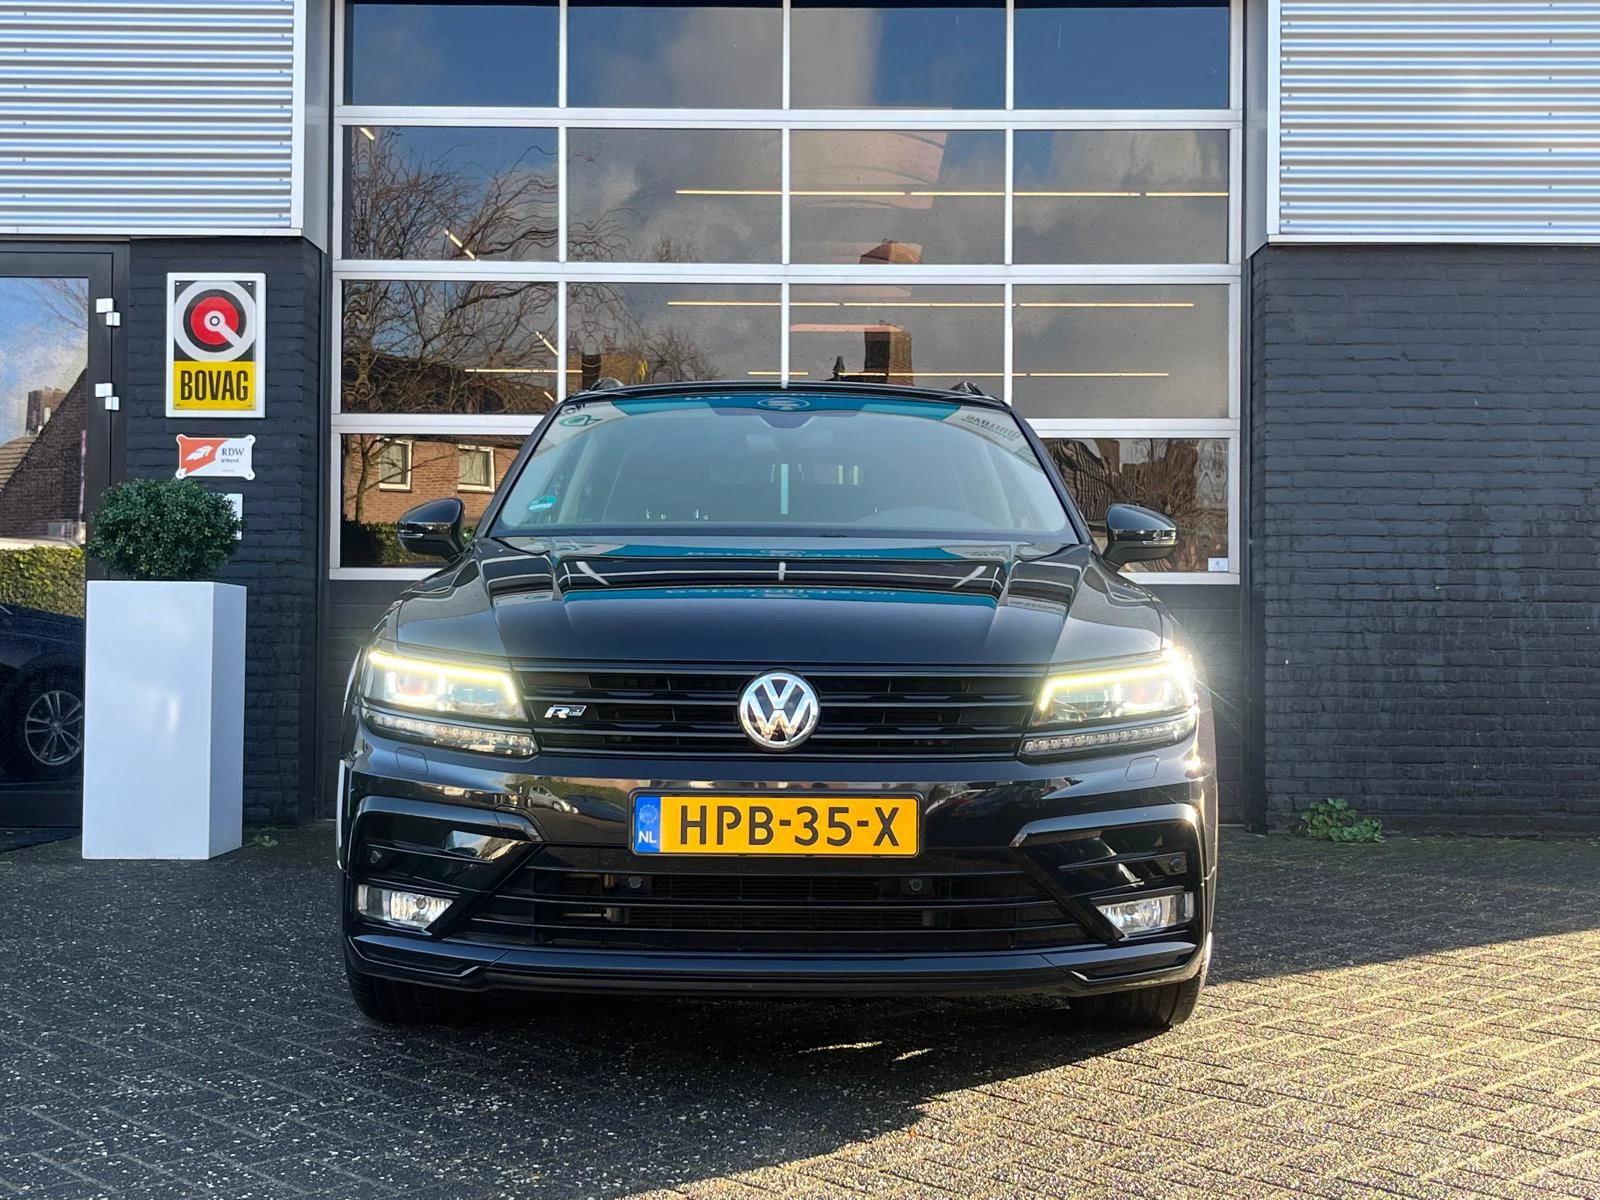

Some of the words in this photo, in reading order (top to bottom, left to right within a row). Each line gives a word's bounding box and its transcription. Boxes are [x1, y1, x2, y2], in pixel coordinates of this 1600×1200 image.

[180, 369, 249, 402] BOVAG
[221, 447, 245, 456] RDW
[638, 830, 658, 844] NL
[679, 804, 900, 847] HPB-35-X
